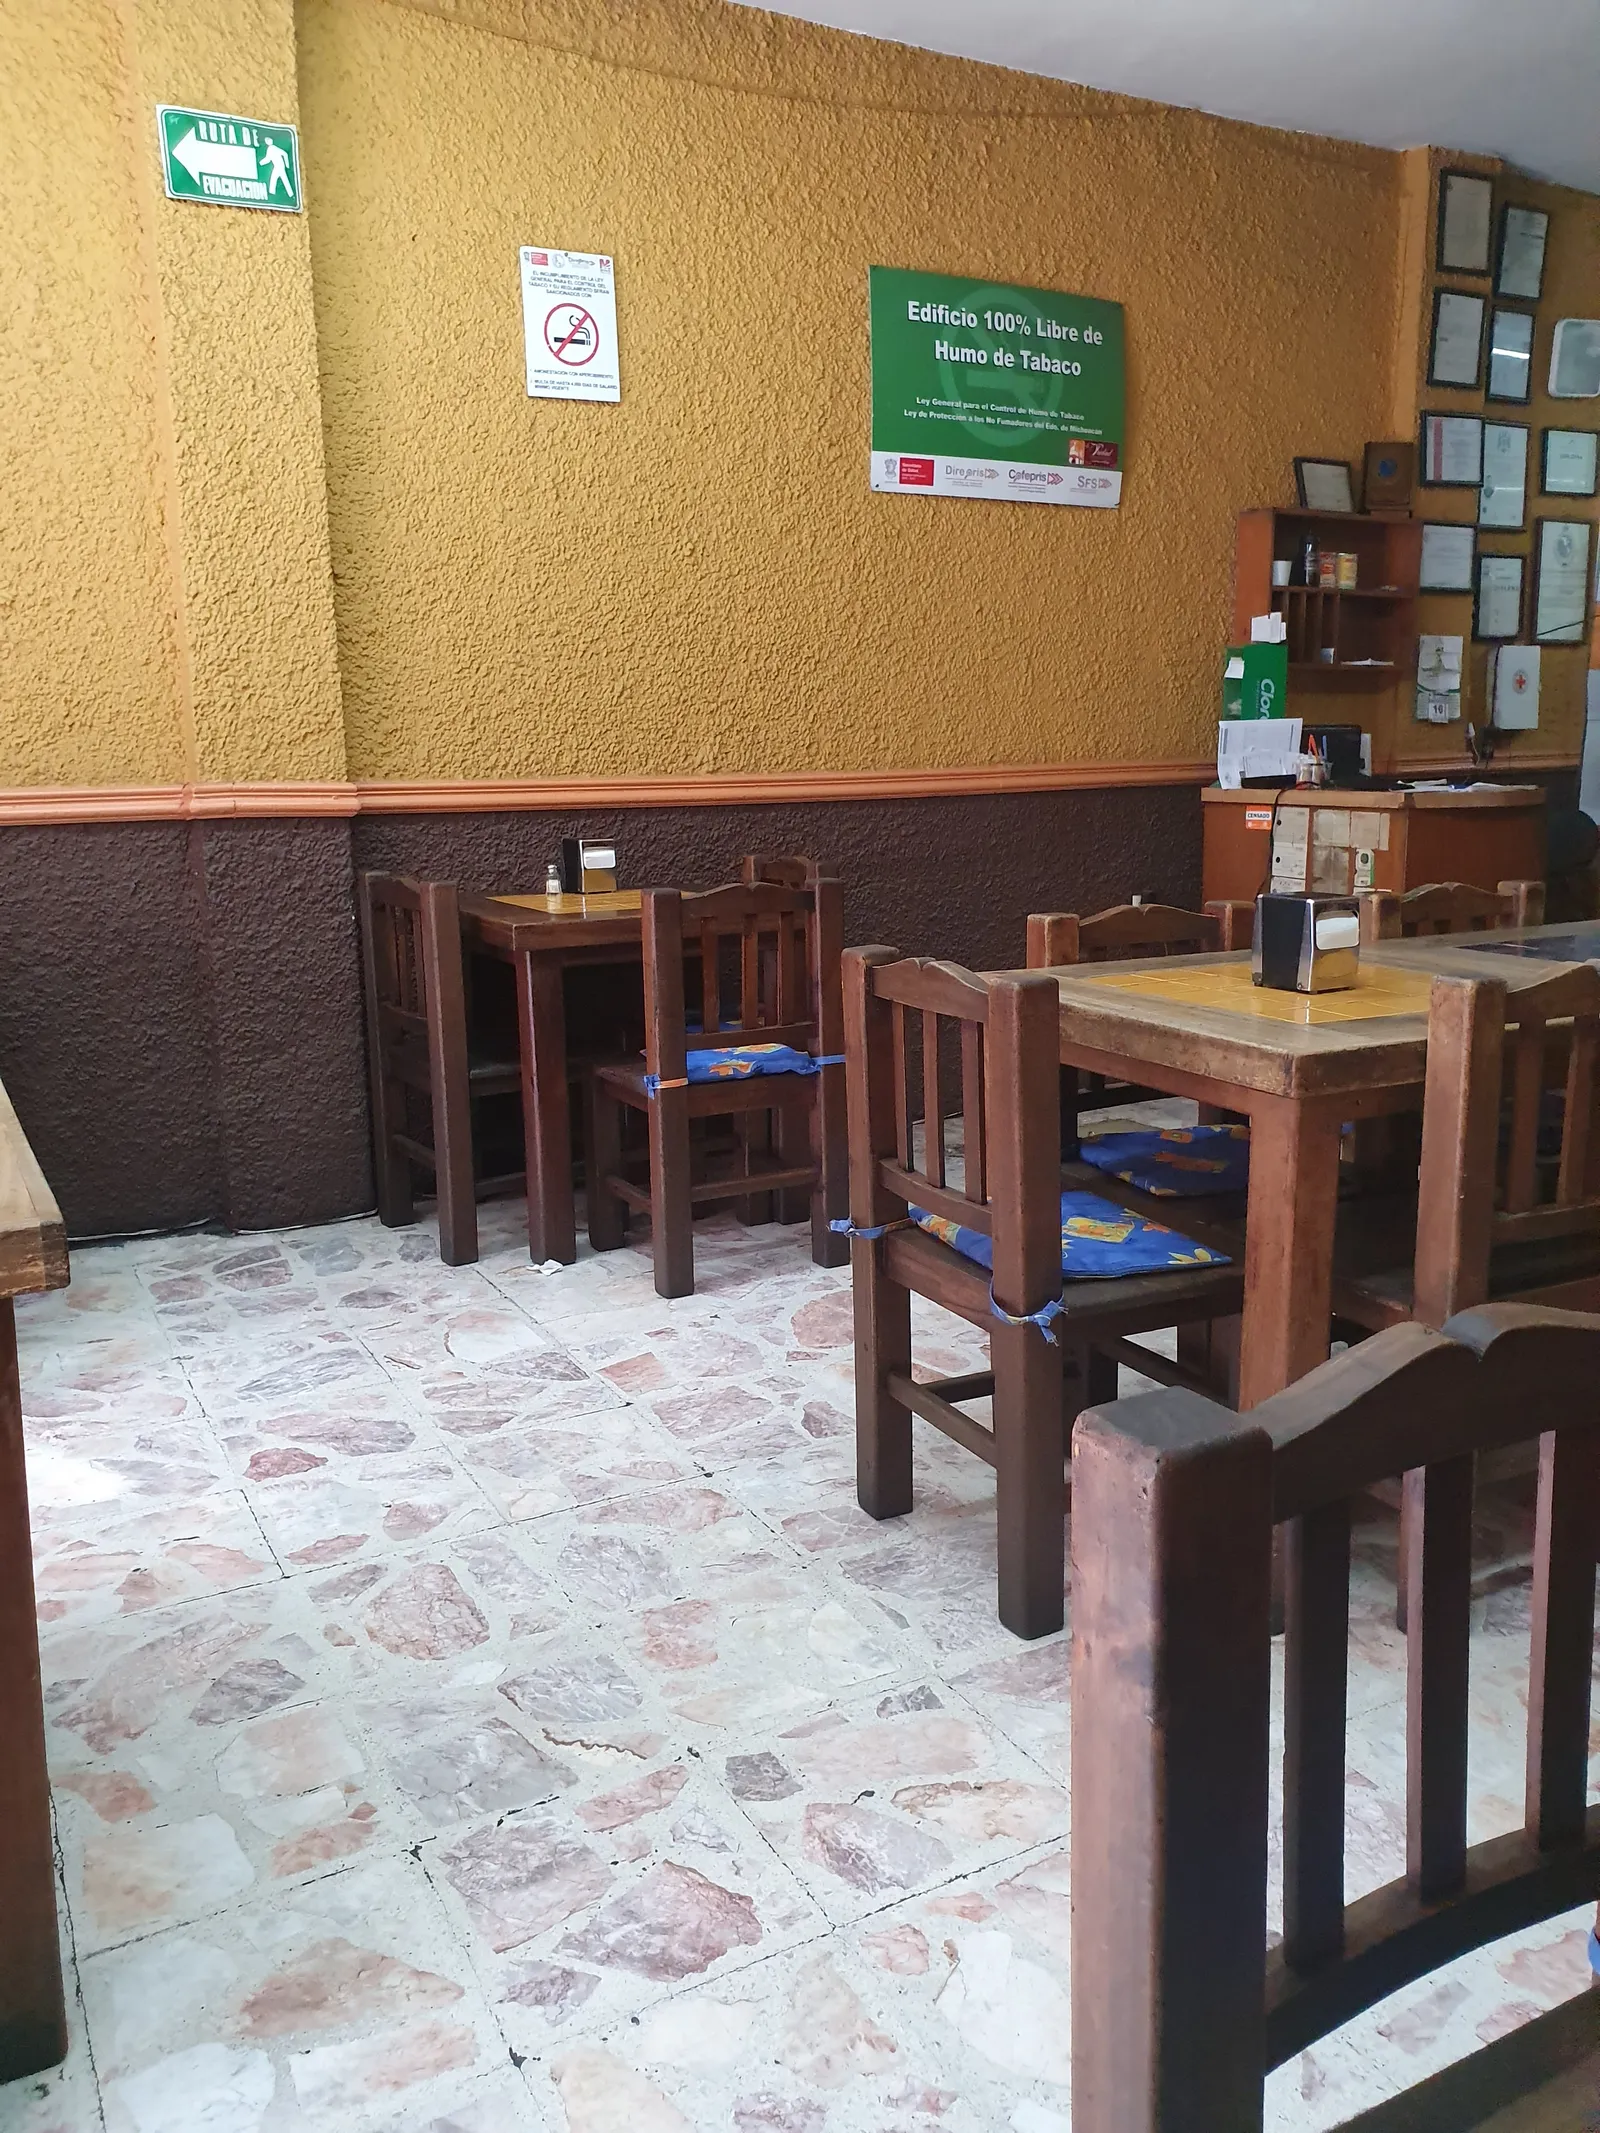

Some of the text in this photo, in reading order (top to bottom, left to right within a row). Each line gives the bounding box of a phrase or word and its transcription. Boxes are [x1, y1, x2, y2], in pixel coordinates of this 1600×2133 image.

[199, 121, 259, 147] RUTA DE
[202, 175, 268, 200] EVACUACION
[908, 300, 1103, 345] Edificio 100% Libre de
[935, 340, 1081, 376] Humo de Tabaco
[904, 409, 917, 418] Ley
[997, 418, 1033, 428] Fumadores
[916, 397, 930, 406] Ley
[932, 398, 961, 408] General
[990, 404, 1016, 413] Control
[1028, 408, 1048, 417] Humo
[1060, 412, 1084, 420] Tabaco
[1077, 476, 1097, 488] SFS
[1260, 679, 1274, 720] Clor
